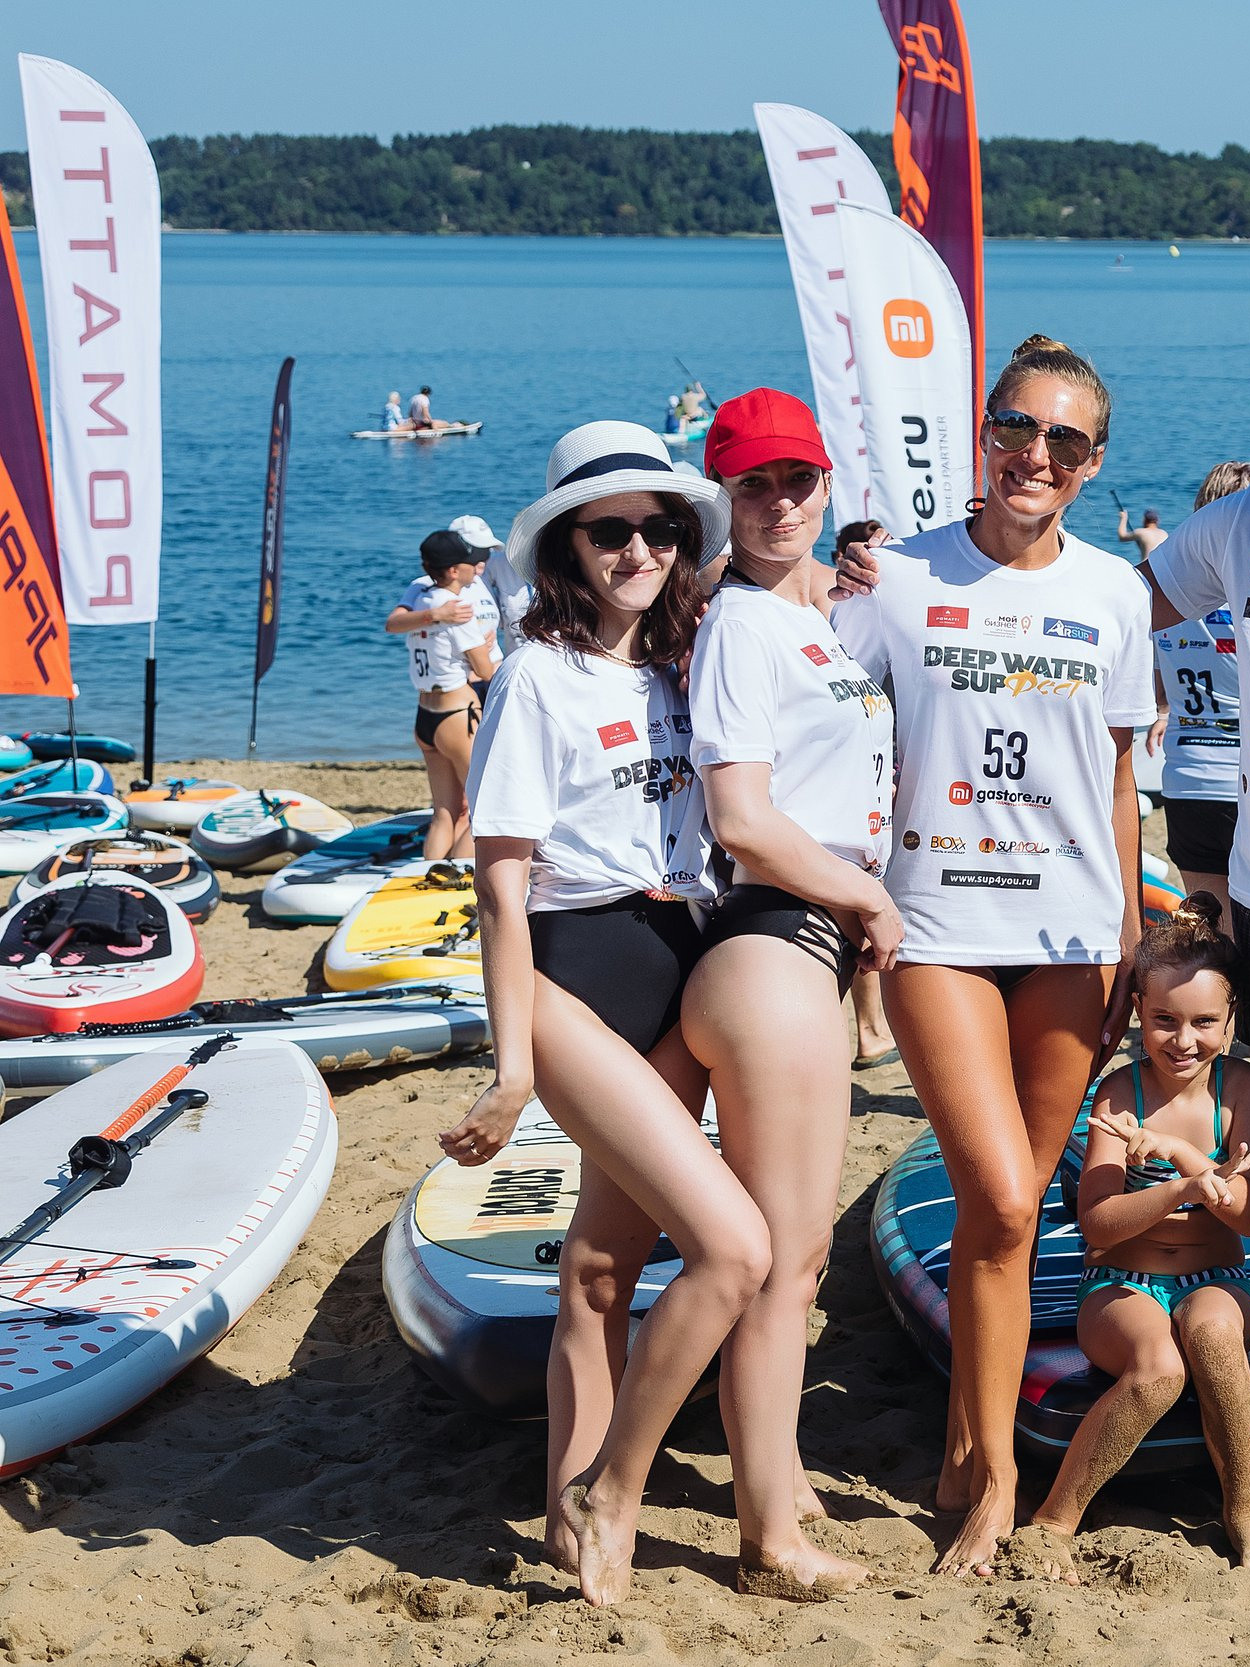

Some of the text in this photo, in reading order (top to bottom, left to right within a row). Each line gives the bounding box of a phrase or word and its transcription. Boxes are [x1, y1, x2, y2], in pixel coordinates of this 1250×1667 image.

[984, 617, 1018, 629] бизнес
[923, 645, 1098, 687] DEEP WATER
[951, 669, 1006, 694] SUP
[983, 728, 1029, 780] 53
[976, 788, 1052, 807] gastore.ru
[950, 874, 1033, 886] www.sup4you.ru
[476, 1169, 565, 1217] BOARDS
